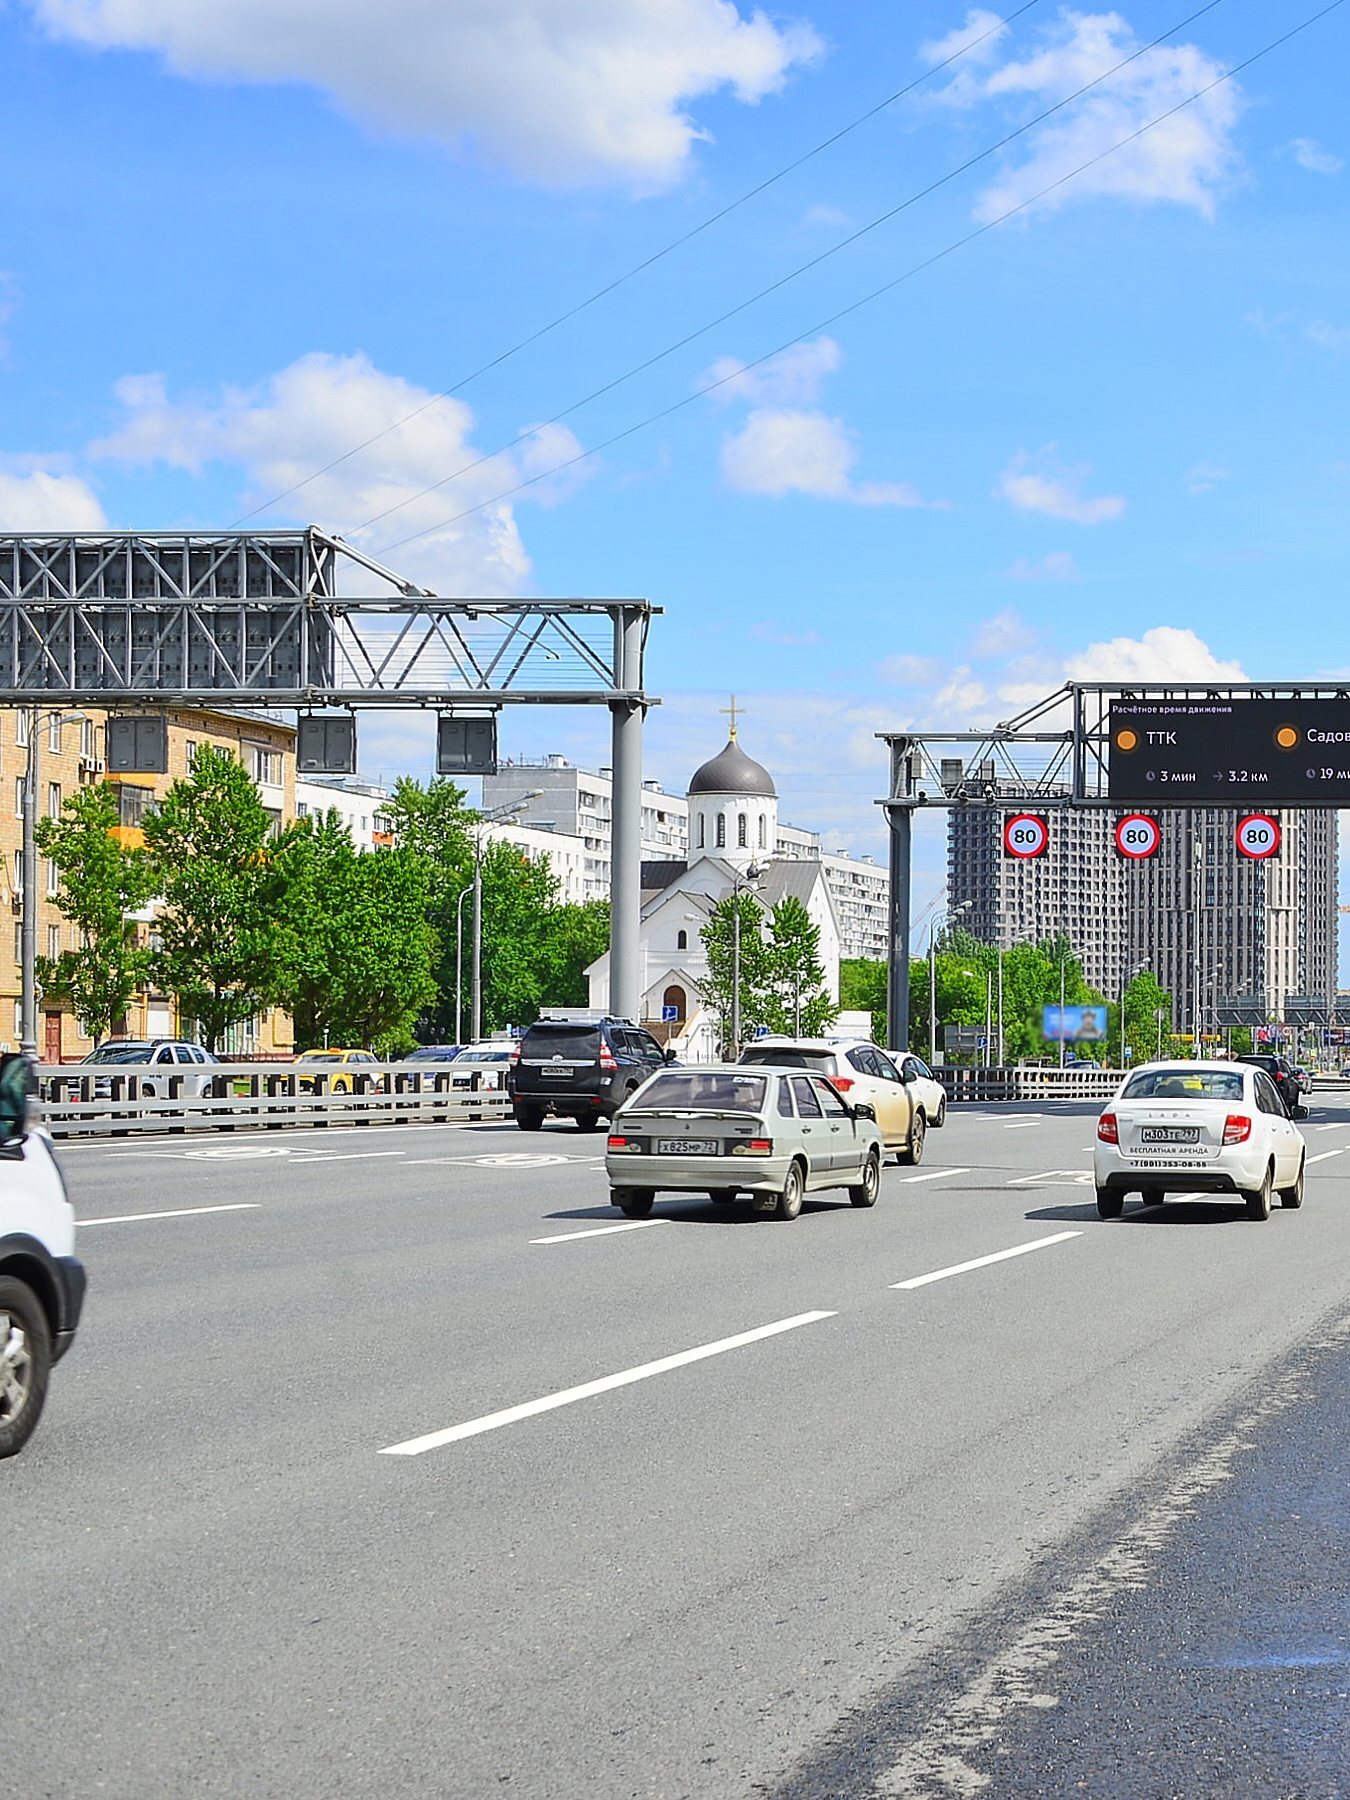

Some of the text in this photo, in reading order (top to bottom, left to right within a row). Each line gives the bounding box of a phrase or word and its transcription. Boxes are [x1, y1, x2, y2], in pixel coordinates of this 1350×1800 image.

[1112, 704, 1233, 714] Расчётное время движения
[1146, 731, 1177, 745] ТТК
[1160, 771, 1197, 782] 3 мин
[1228, 771, 1269, 783] 3.2 км
[1319, 769, 1333, 780] 19
[1014, 828, 1037, 845] 80
[1126, 829, 1149, 845] 80
[1246, 829, 1269, 845] 80
